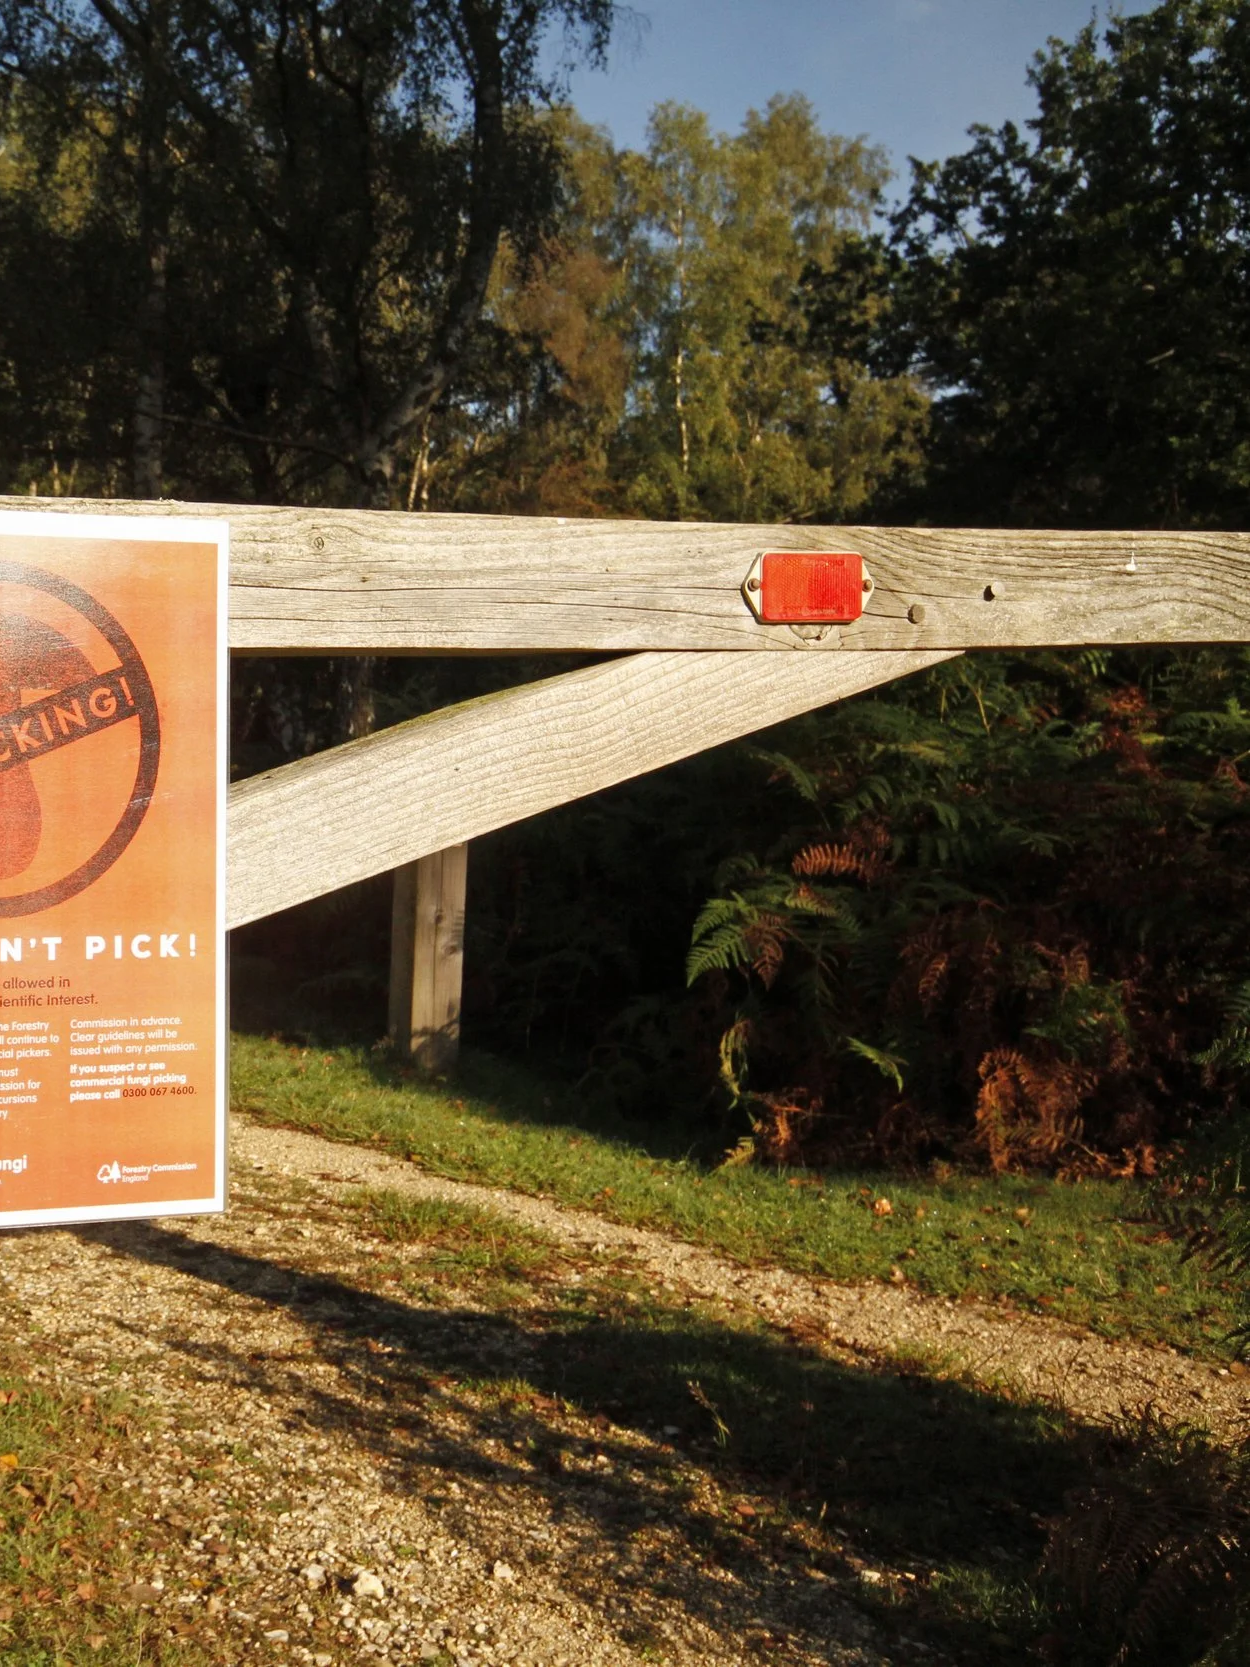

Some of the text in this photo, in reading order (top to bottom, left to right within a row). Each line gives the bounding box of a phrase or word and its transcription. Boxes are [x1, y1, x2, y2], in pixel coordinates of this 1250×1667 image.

[85, 934, 197, 960] PICK!
[3, 975, 54, 990] allowed
[59, 975, 70, 988] in
[47, 993, 99, 1006] Interest.
[12, 1022, 49, 1032] Forestry
[70, 1017, 182, 1029] Commission in advance.
[7, 1036, 47, 1045] continue
[50, 1034, 59, 1044] to
[70, 1029, 177, 1043] Clear guidelines will be
[16, 1048, 52, 1060] pickers.
[70, 1046, 100, 1055] issued
[104, 1045, 122, 1054] with
[125, 1046, 142, 1056] any
[70, 1062, 165, 1075] If you suspect or see
[28, 1080, 41, 1089] for
[70, 1074, 186, 1087] commercial fungi picking
[70, 1086, 197, 1103] please call 0300 067 4600.
[122, 1163, 197, 1175] Forestry Commission
[122, 1174, 149, 1183] England
